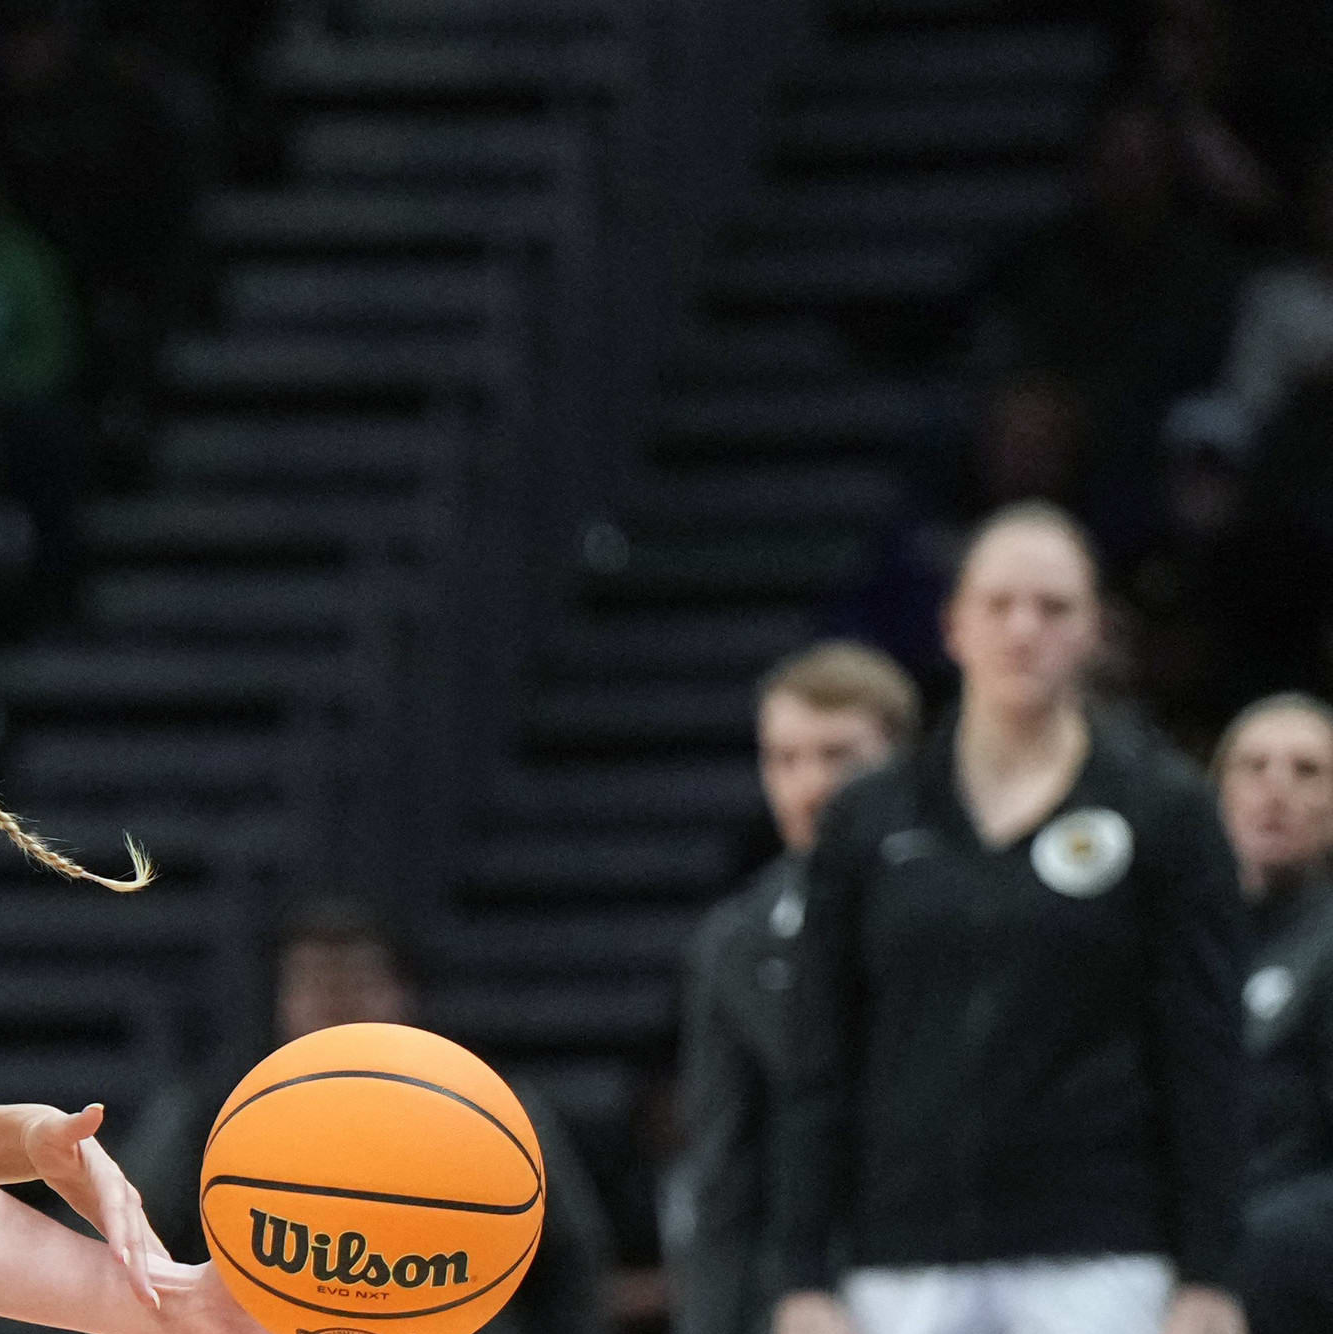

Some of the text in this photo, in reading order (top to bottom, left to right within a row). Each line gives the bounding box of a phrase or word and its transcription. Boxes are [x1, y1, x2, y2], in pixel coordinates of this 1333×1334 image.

[249, 1206, 469, 1289] Wilson
[317, 1285, 390, 1300] EVO NXT
